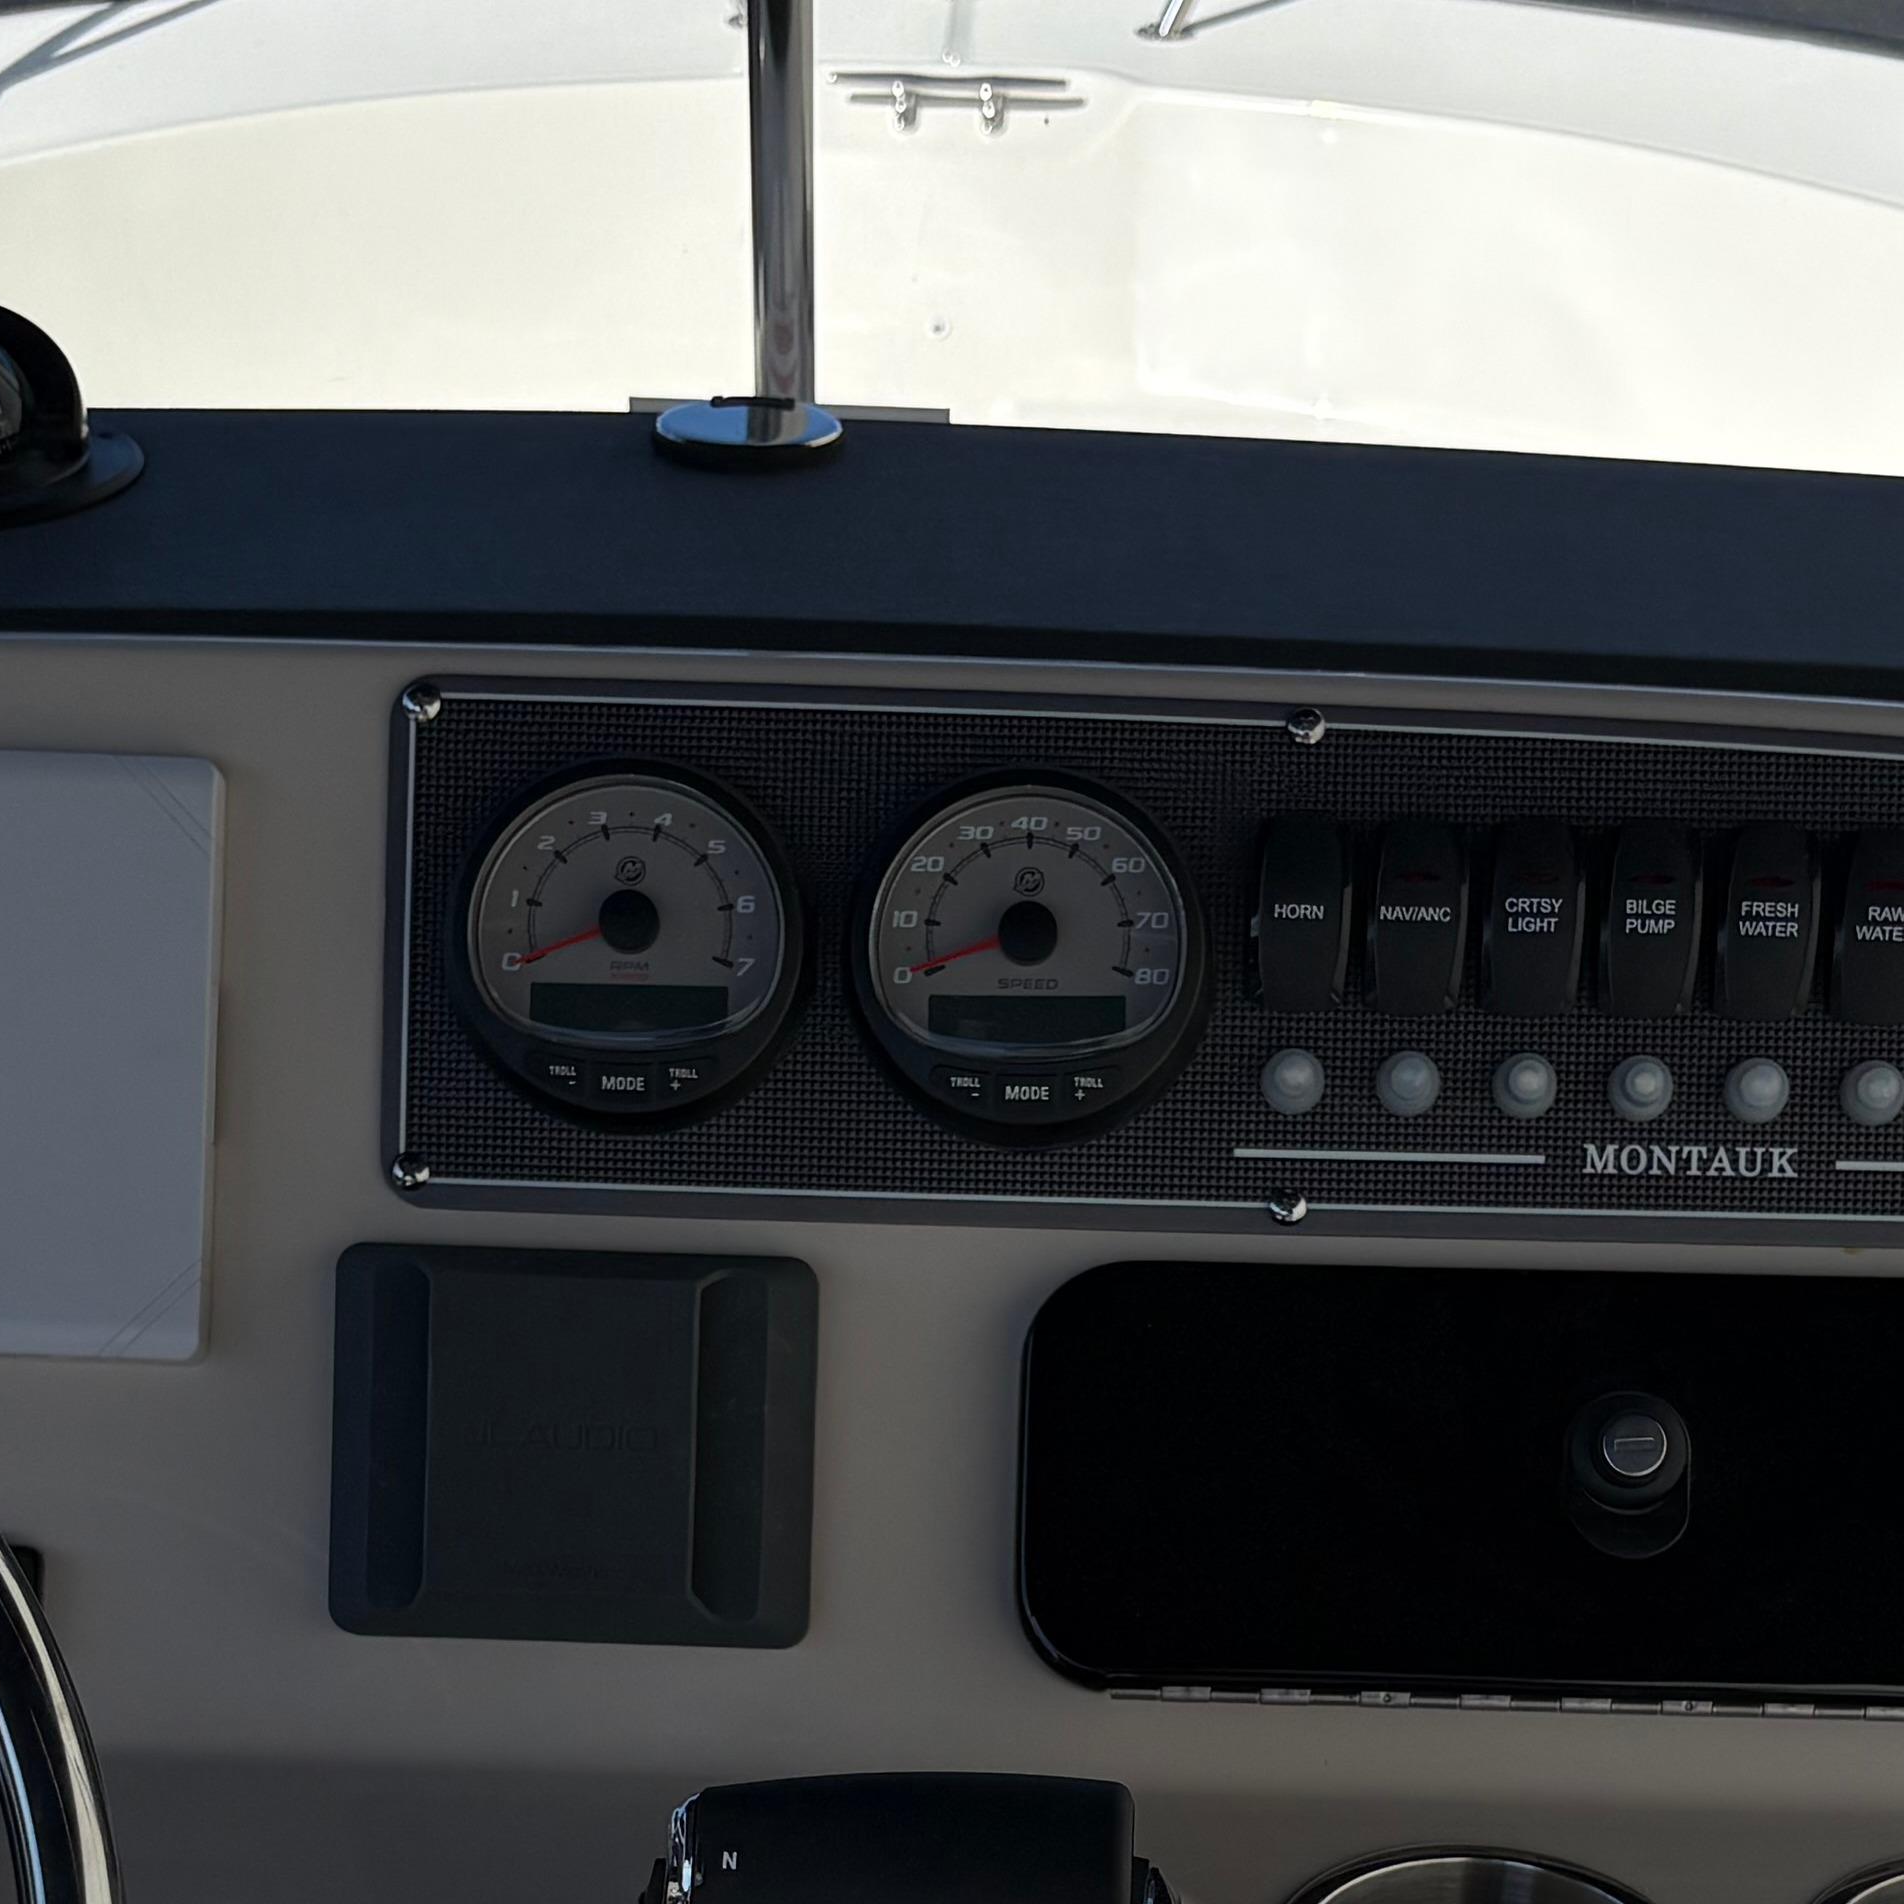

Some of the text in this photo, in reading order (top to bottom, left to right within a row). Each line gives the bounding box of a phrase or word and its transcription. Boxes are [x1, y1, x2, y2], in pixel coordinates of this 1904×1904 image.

[588, 812, 607, 824] 3
[654, 813, 673, 826] 4
[1011, 817, 1048, 831] 40
[957, 826, 994, 840] 30
[1066, 827, 1101, 841] 50
[538, 836, 556, 850] 2
[708, 840, 726, 854] 5
[910, 857, 944, 872] 20
[1112, 857, 1145, 873] 60
[511, 890, 519, 906] 1
[736, 896, 755, 913] 6
[1505, 898, 1563, 914] CRTSY
[1274, 903, 1324, 920] HORN
[1379, 905, 1451, 923] NAV/ANC
[1626, 900, 1677, 916] BILGE
[1741, 901, 1799, 919] FRESH
[892, 911, 918, 927] 10
[1135, 912, 1169, 929] 70
[1507, 917, 1559, 933] LIGHT
[1625, 919, 1675, 935] PUMP
[1738, 920, 1799, 938] WATER
[609, 961, 649, 971] RPM
[736, 958, 755, 977] 7
[893, 967, 912, 984] 0
[1134, 968, 1169, 985] 80
[998, 978, 1058, 990] SPEED
[549, 1066, 576, 1076] TROLL
[669, 1068, 698, 1079] TROLL
[602, 1076, 645, 1091] MODE
[950, 1076, 980, 1087] TROLL
[1074, 1077, 1103, 1088] TROLL
[1005, 1086, 1049, 1100] MODE
[1582, 1143, 1799, 1178] MONTAUK
[722, 1850, 738, 1870] N
